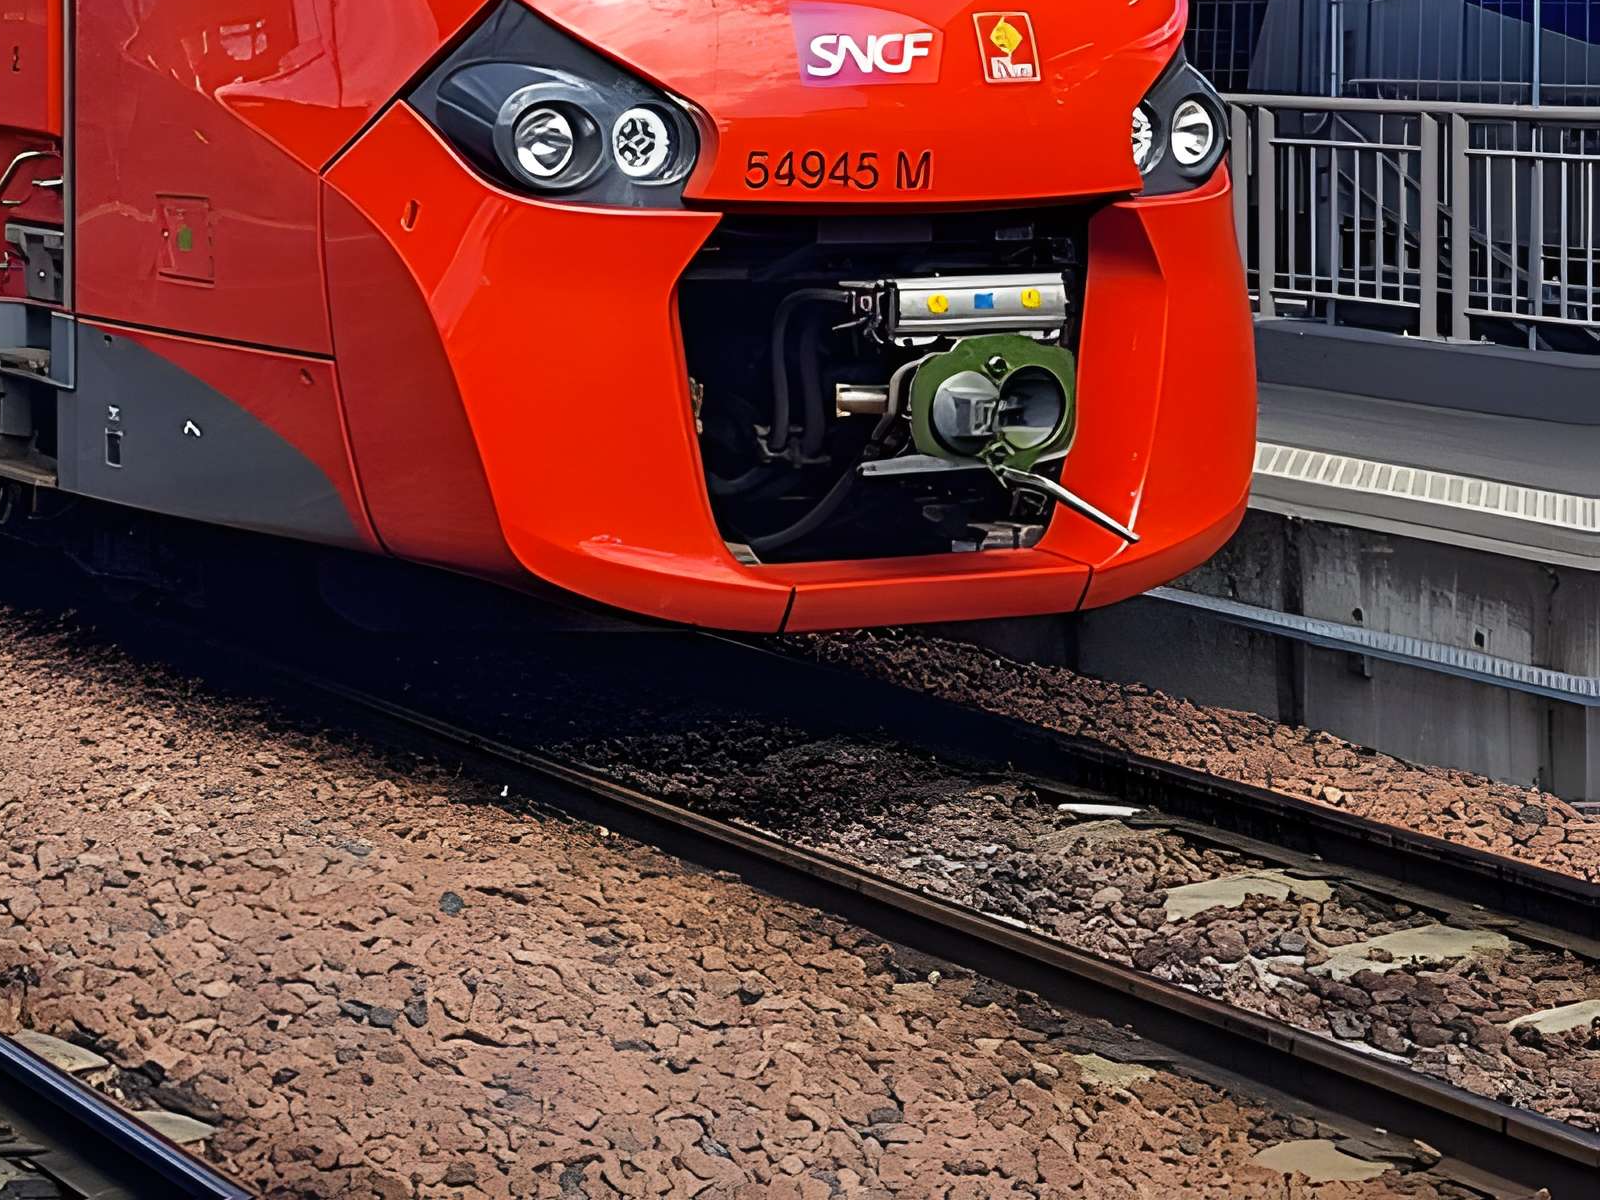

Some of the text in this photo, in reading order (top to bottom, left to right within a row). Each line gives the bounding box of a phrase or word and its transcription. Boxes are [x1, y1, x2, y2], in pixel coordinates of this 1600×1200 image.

[807, 32, 933, 77] SNCF
[744, 150, 933, 190] 54945 M
